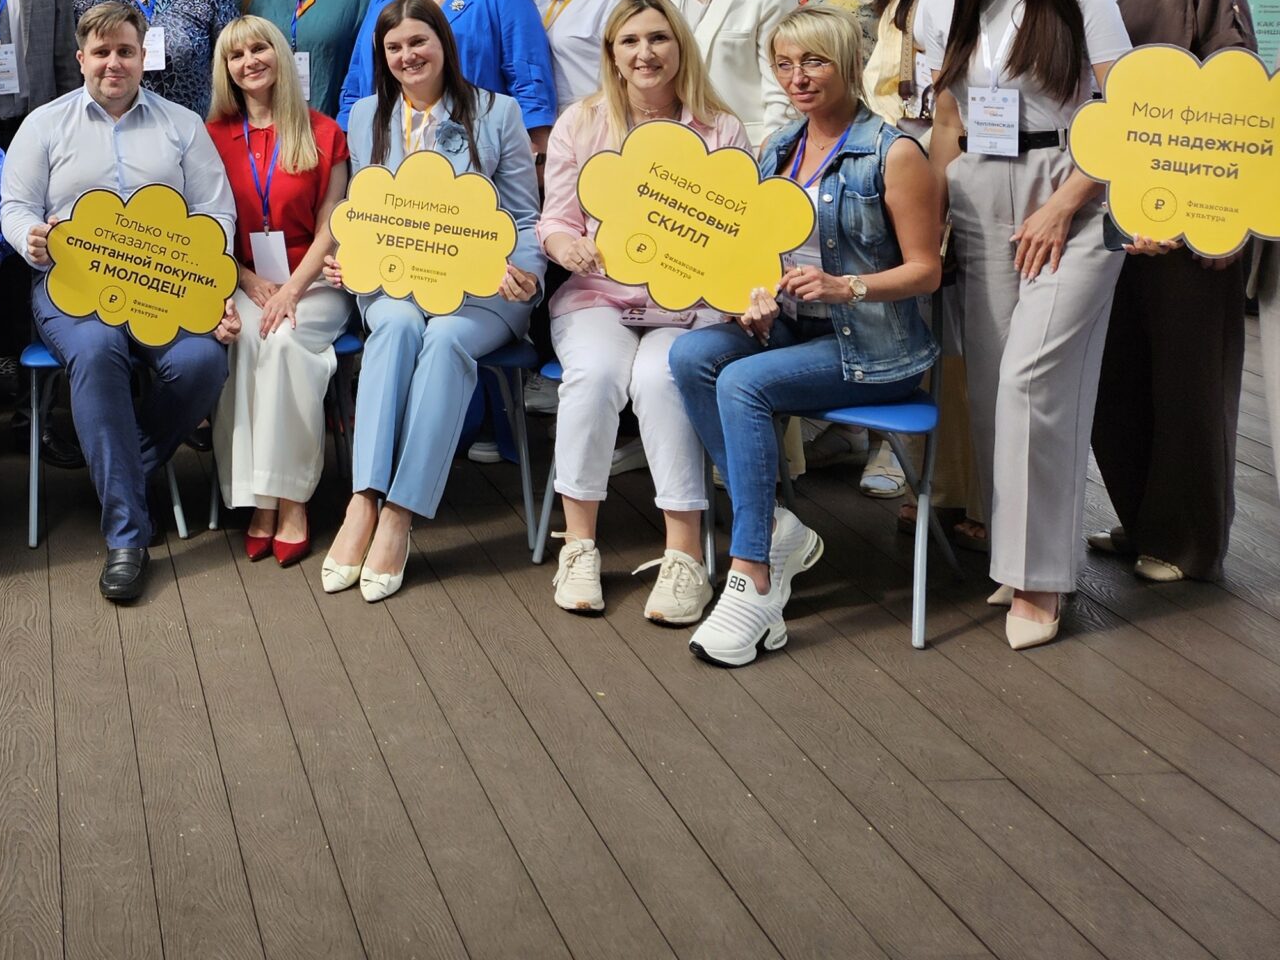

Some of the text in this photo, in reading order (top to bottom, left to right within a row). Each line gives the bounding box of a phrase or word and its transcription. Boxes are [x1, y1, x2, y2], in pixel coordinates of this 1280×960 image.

[1132, 101, 1275, 129] Мои финансы
[1126, 130, 1274, 157] под надежной
[1150, 158, 1239, 180] защитой
[648, 161, 748, 216] Качаю свой
[384, 193, 460, 216] Принимаю
[636, 181, 741, 238] финансовый
[1185, 211, 1226, 222] культура
[115, 212, 191, 247] Только что
[345, 207, 498, 241] финансовые решения
[647, 210, 710, 248] СКИЛЛ
[94, 227, 167, 257] отказался
[376, 232, 459, 257] УВЕРЕННО
[66, 236, 218, 289] спонтанной покупки.
[660, 262, 692, 280] культура
[88, 260, 187, 299] Я МОЛОДЕЦ!
[410, 274, 438, 284] культура
[130, 307, 158, 320] культура
